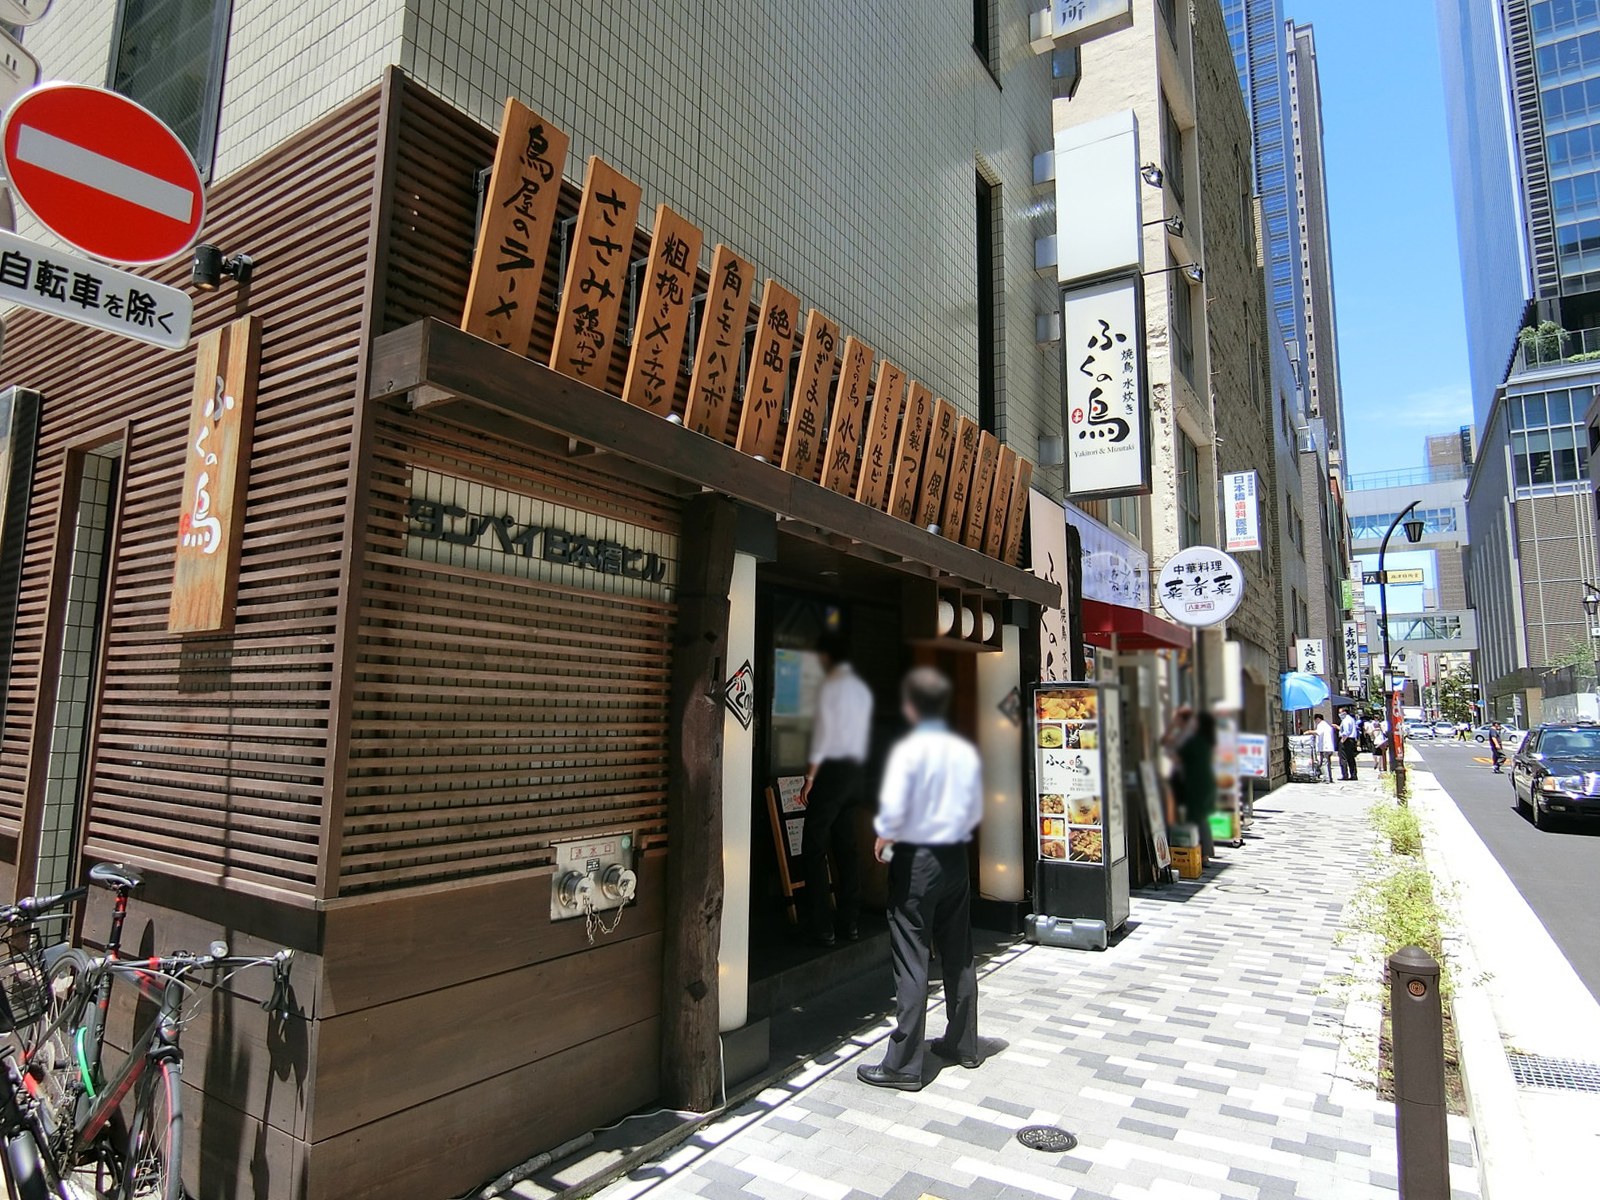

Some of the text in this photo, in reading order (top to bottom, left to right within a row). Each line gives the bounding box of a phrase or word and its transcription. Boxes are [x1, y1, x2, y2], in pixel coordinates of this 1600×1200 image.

[0, 250, 175, 334] 自転車を除く
[569, 188, 627, 376] ささみ鶏わさ
[640, 232, 691, 407] 粗挽きメンチカツ
[753, 304, 792, 445] 絶品レバー
[794, 322, 834, 475] ねぎま串焼き
[1079, 319, 1130, 442] ふくの鳥
[182, 375, 235, 554] ふくの鳥
[1073, 444, 1135, 458] Yakitori & Mizutaki
[1233, 475, 1248, 536] 日本橋歯科医院
[1173, 560, 1222, 575] 中華料理
[1363, 575, 1376, 583] 7A
